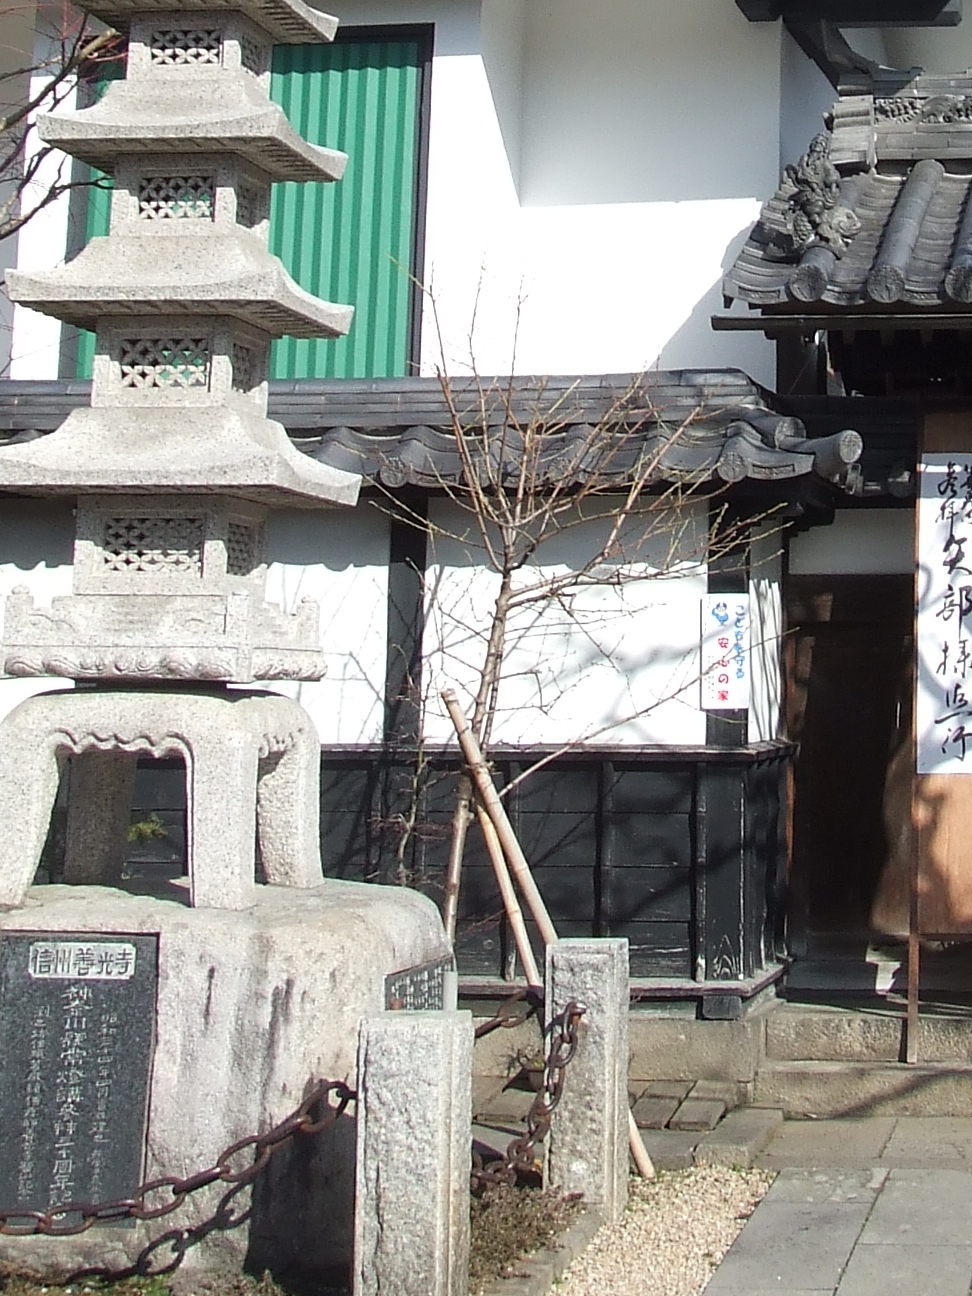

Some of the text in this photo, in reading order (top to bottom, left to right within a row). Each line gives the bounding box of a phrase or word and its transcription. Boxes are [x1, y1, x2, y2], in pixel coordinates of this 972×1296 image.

[31, 948, 133, 976] 信州善光寺
